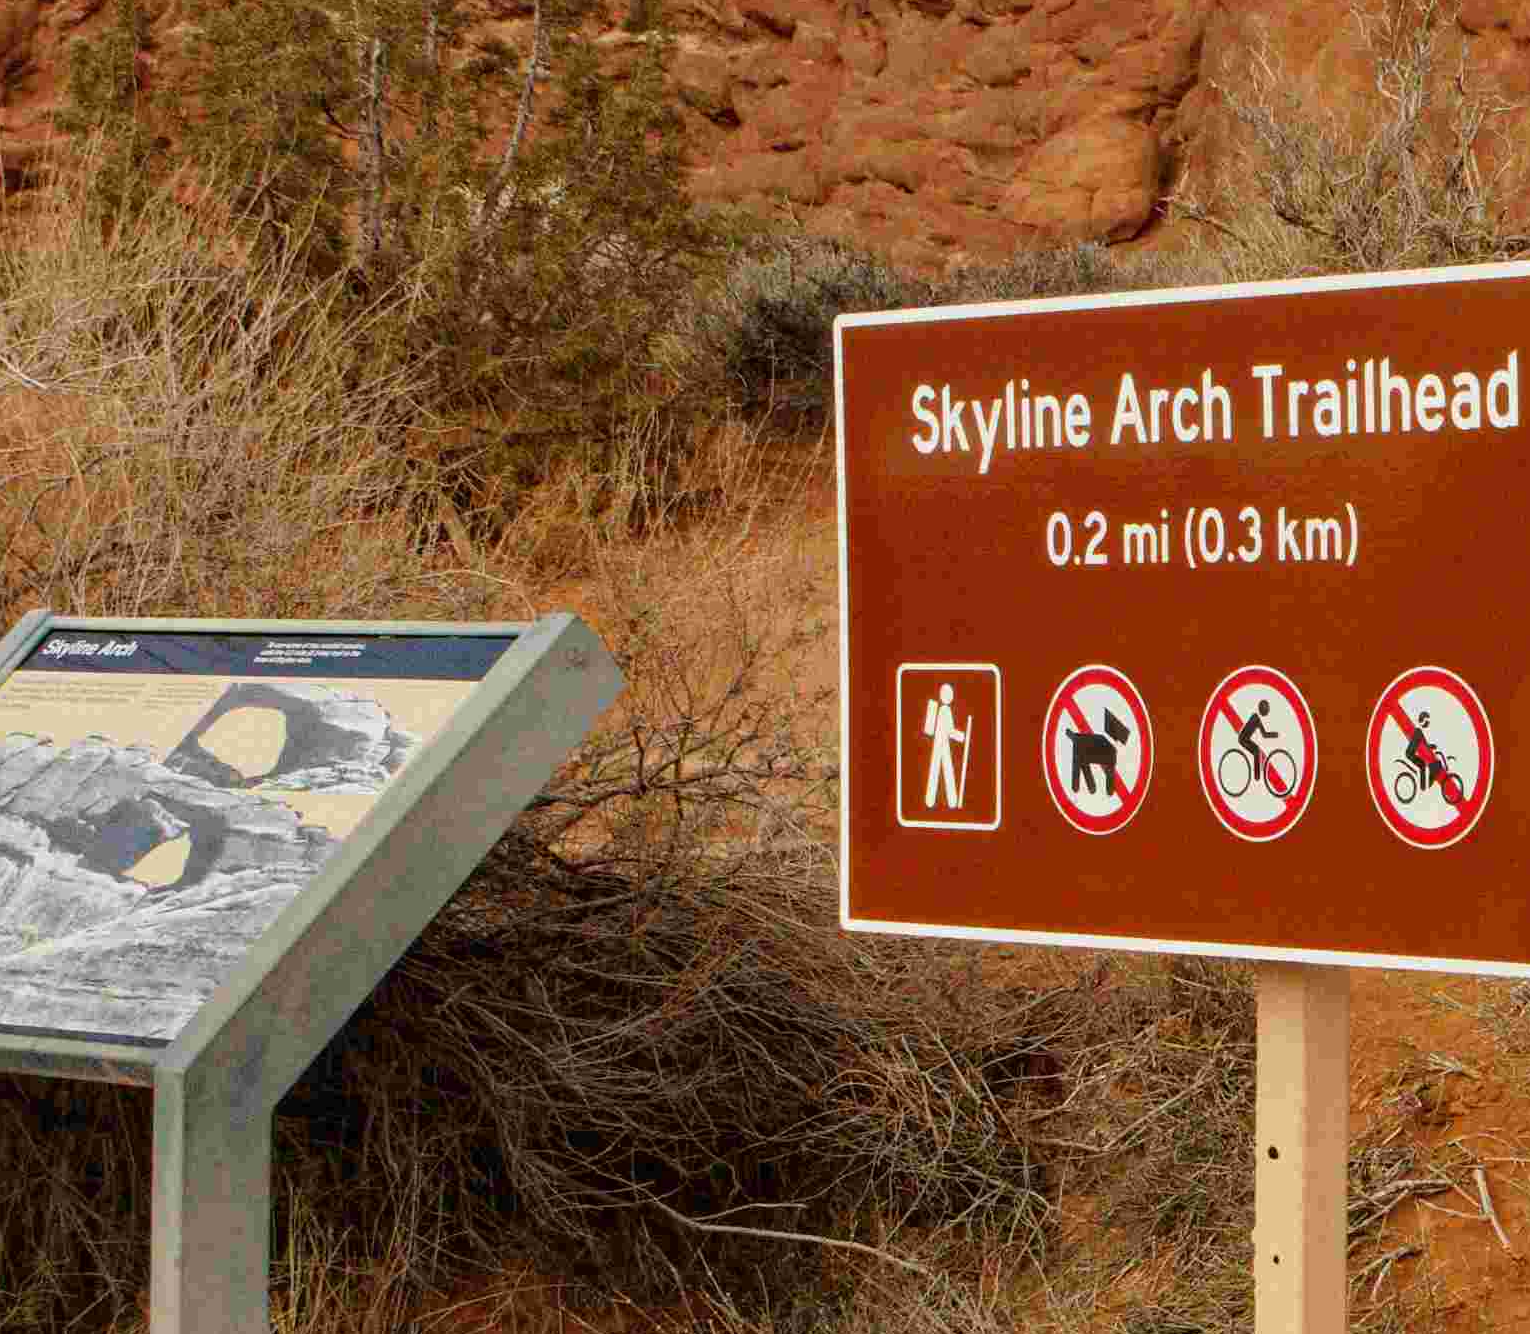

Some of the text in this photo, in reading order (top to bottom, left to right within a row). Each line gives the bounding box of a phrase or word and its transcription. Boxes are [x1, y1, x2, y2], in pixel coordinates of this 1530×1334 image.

[911, 350, 1520, 475] Skyline Arch Trailhead
[1046, 503, 1360, 570] 0.2 mi (0.3 km)
[96, 640, 138, 657] Arch
